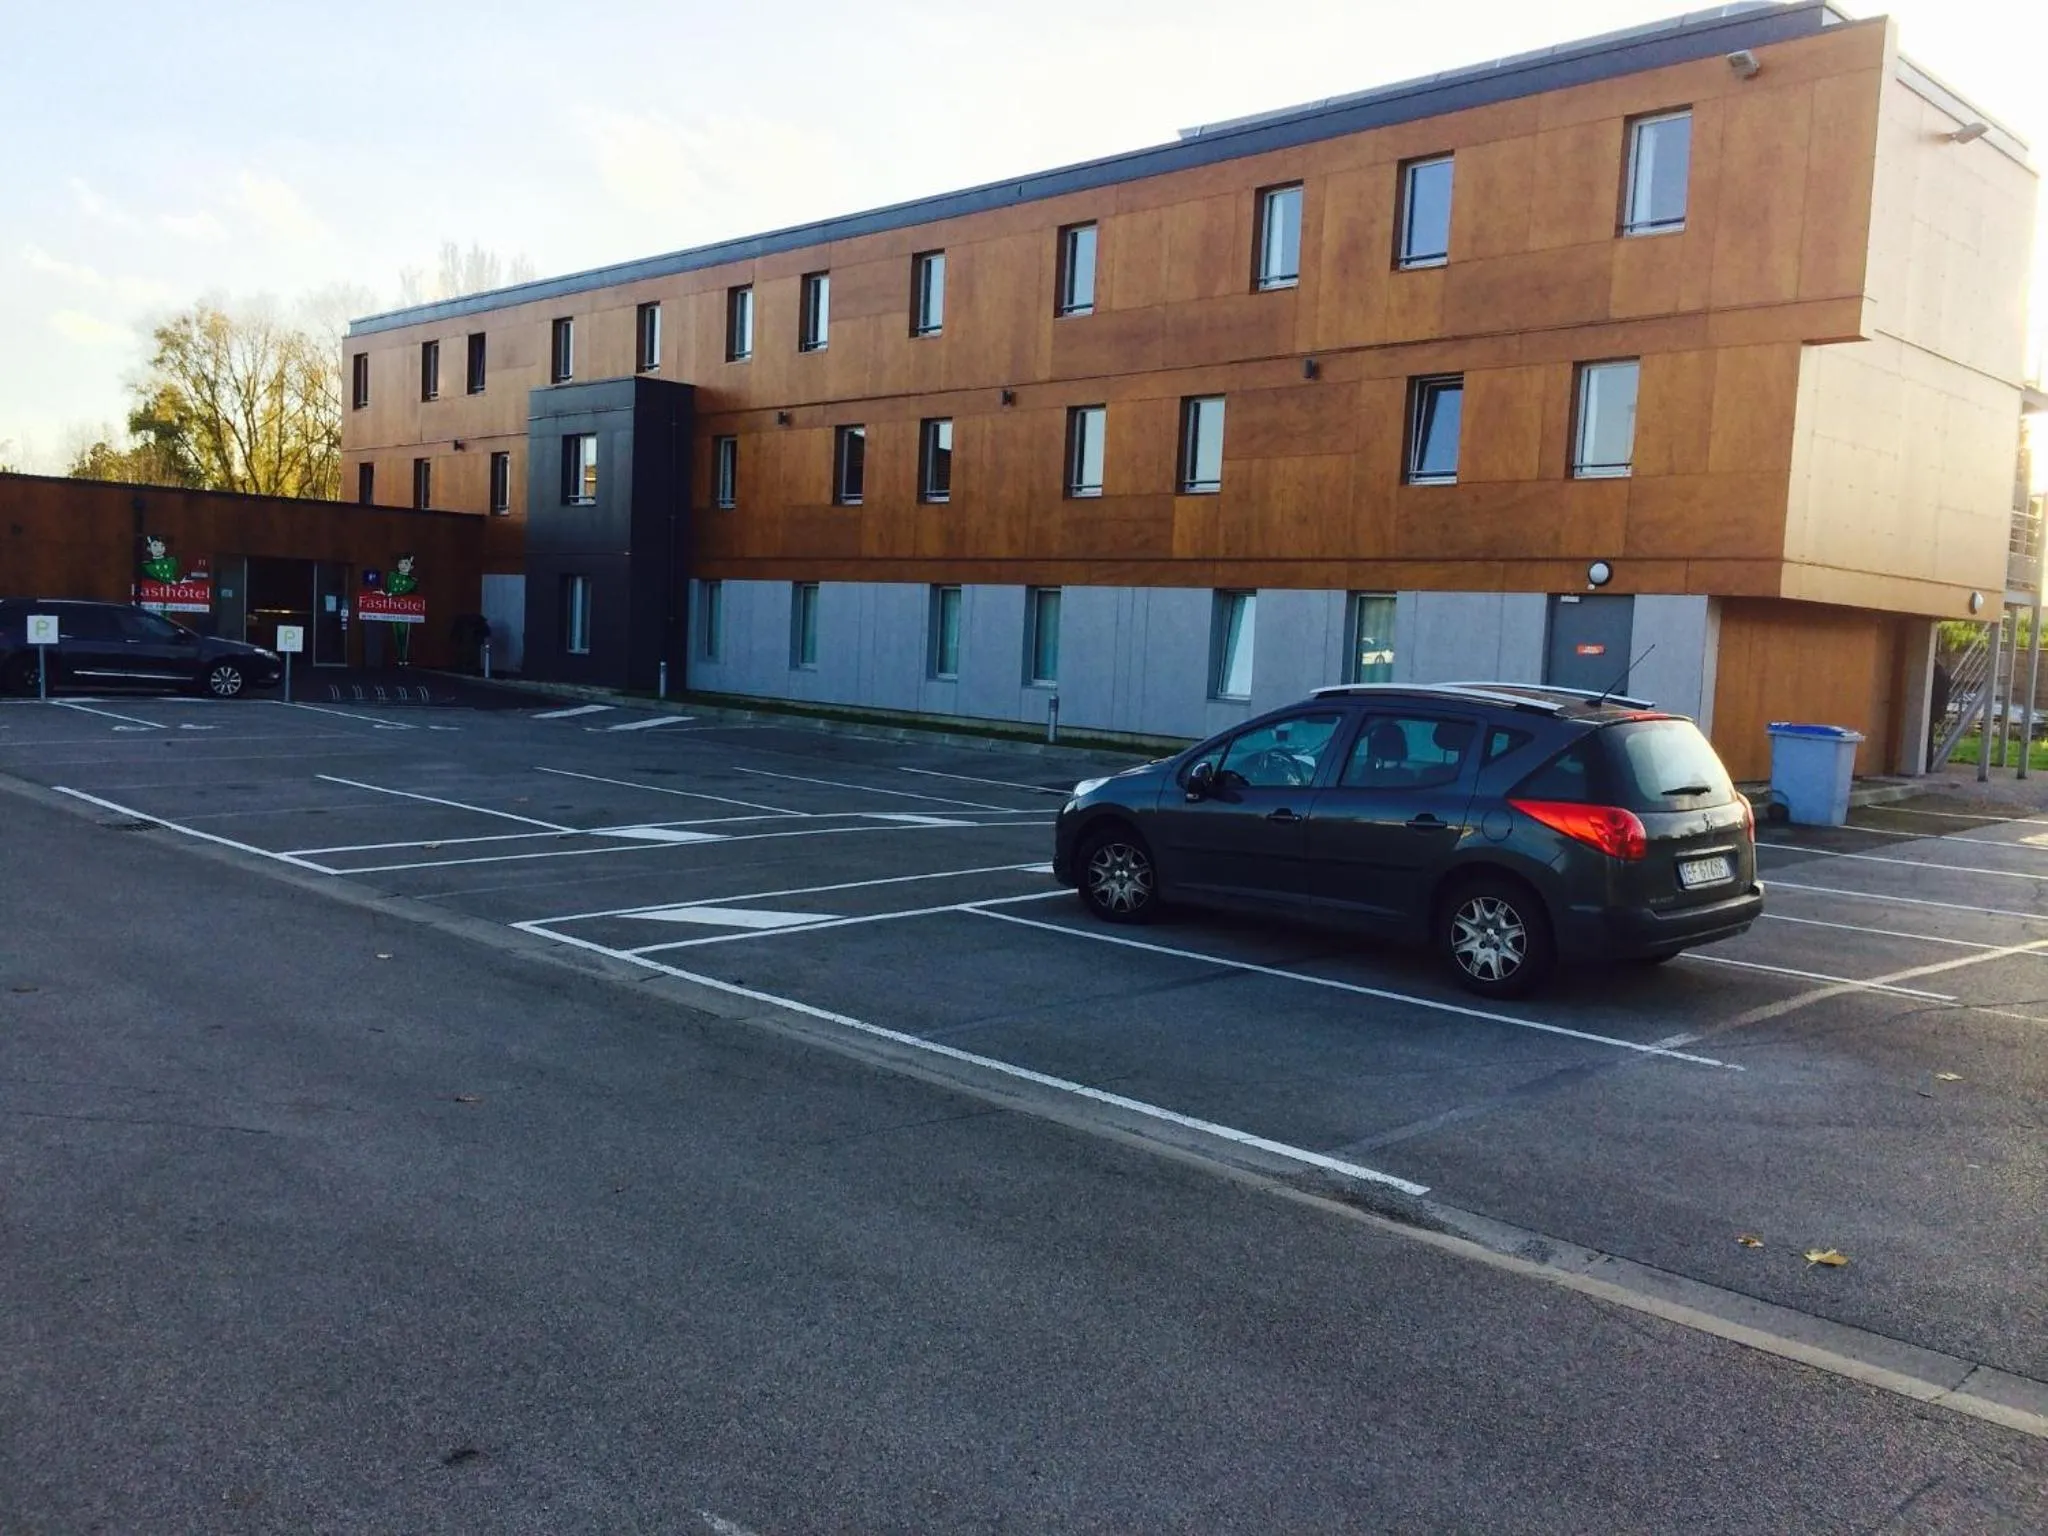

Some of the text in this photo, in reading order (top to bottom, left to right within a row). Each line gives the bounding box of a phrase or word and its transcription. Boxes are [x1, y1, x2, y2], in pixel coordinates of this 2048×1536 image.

[359, 596, 426, 611] Fasthôtel
[36, 619, 49, 636] P
[284, 630, 296, 645] P
